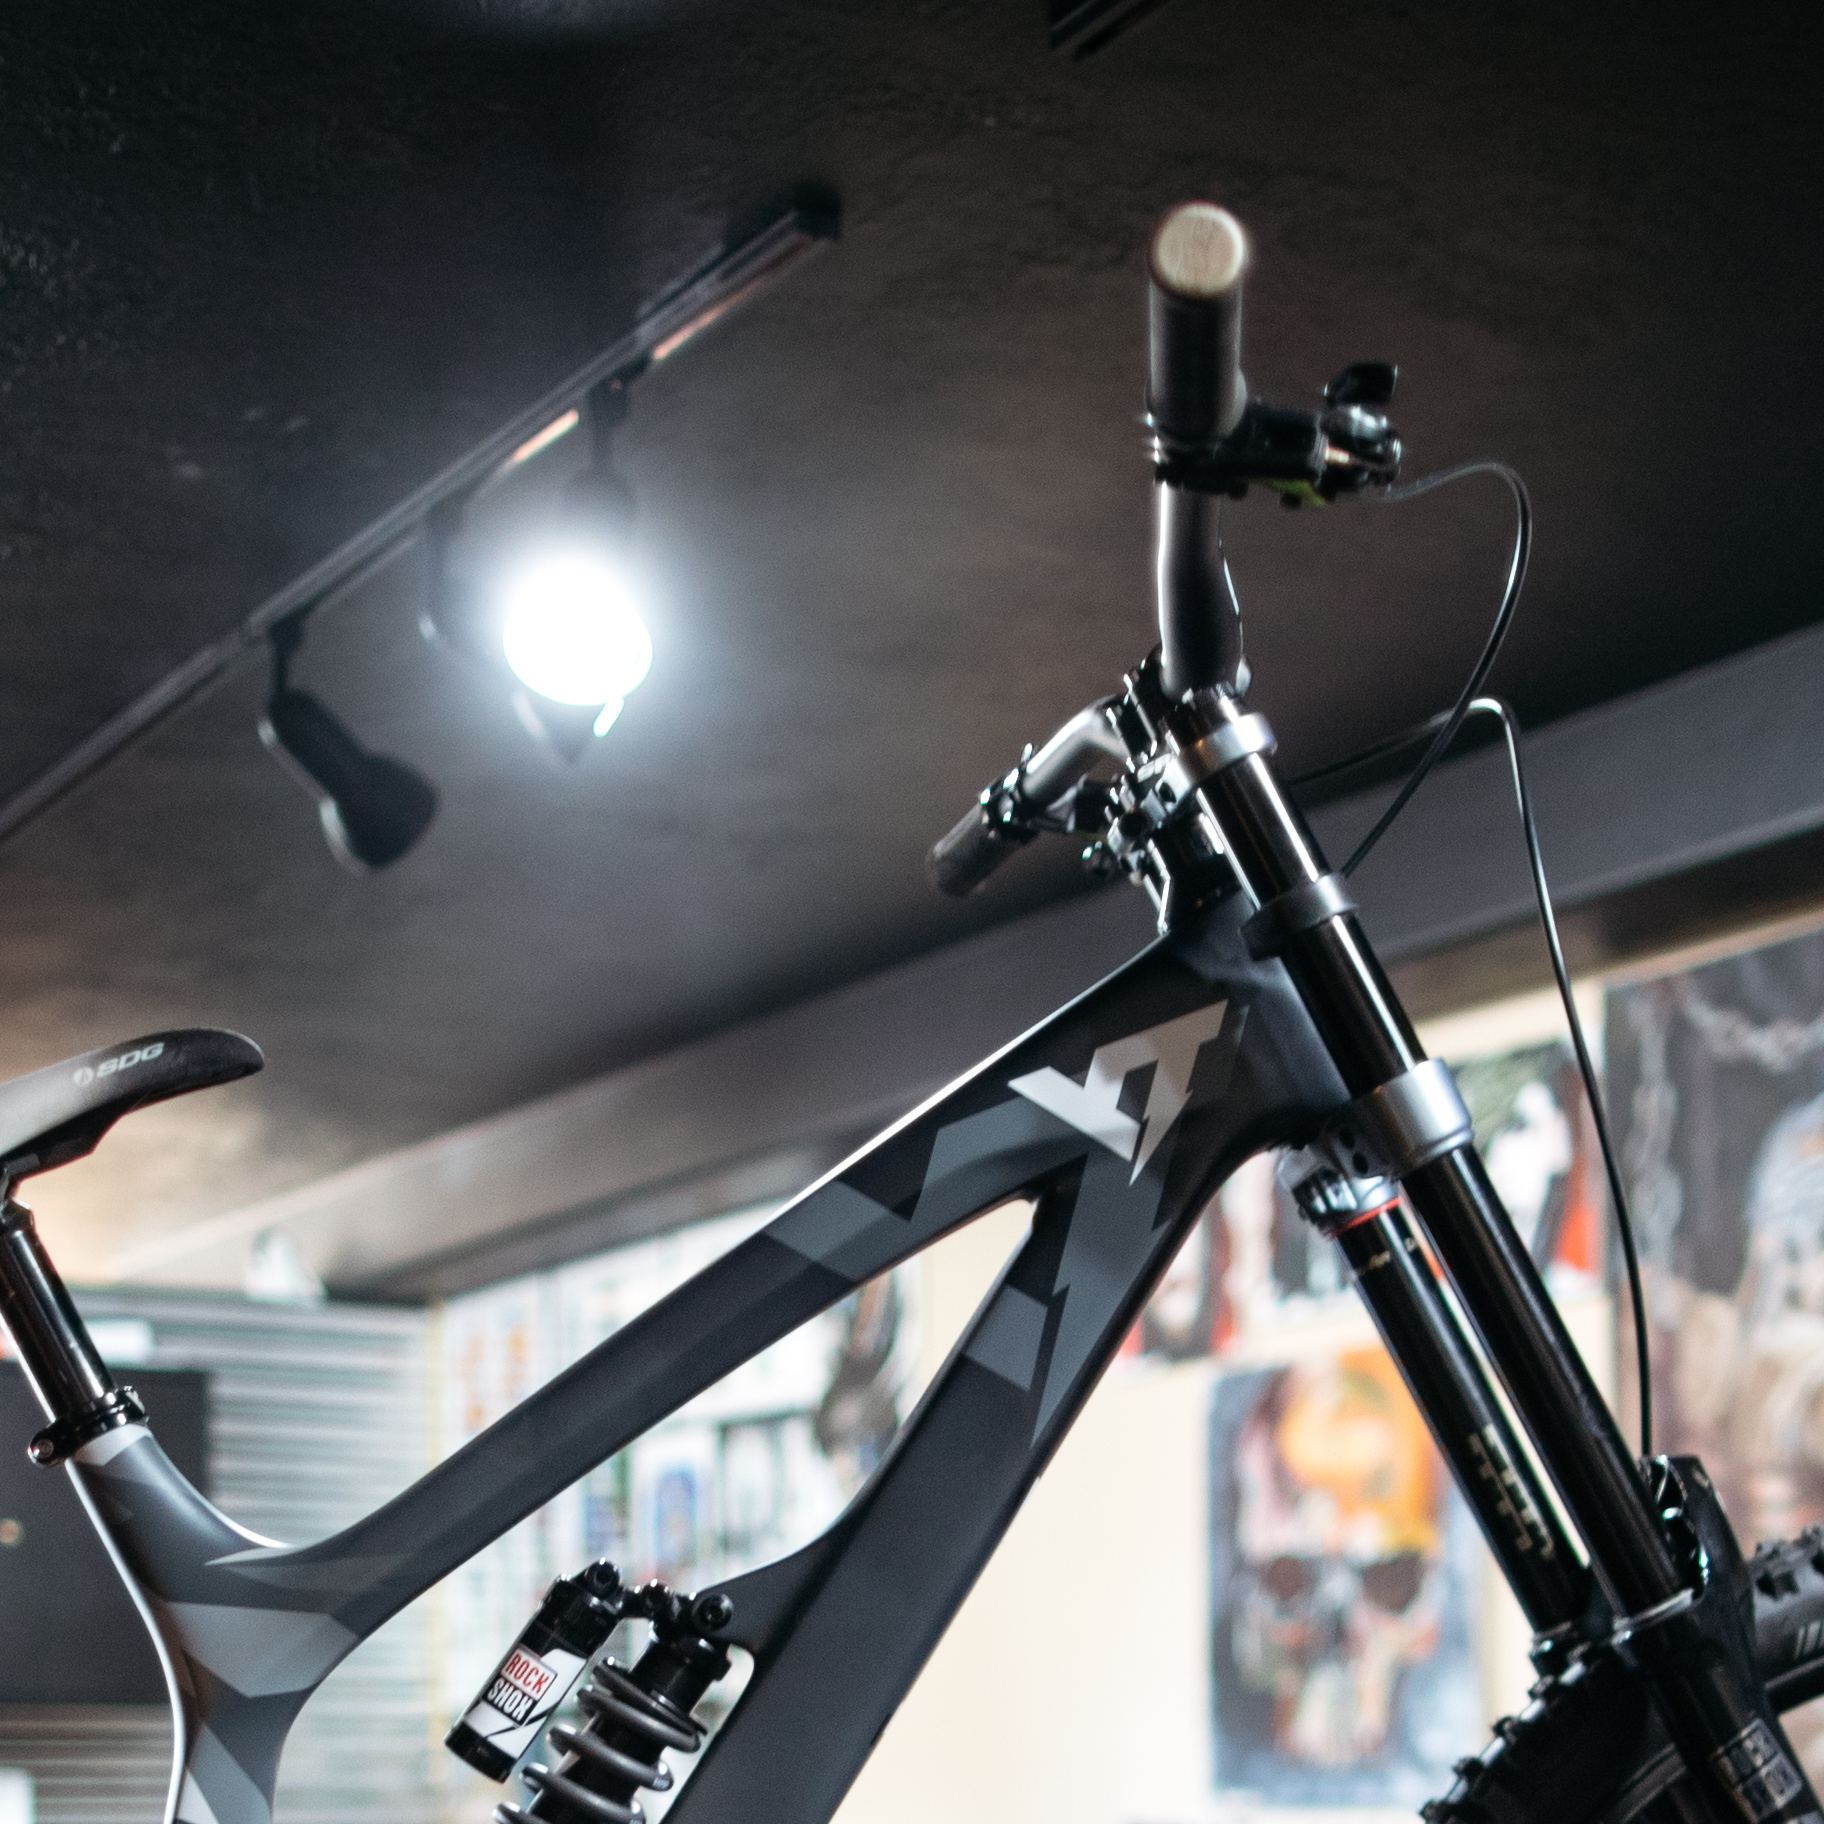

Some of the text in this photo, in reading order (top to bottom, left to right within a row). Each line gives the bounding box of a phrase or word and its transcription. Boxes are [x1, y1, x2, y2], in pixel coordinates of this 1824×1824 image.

[97, 1042, 165, 1078] SDG
[505, 1652, 549, 1694] ROCK
[487, 1677, 533, 1722] SHOX
